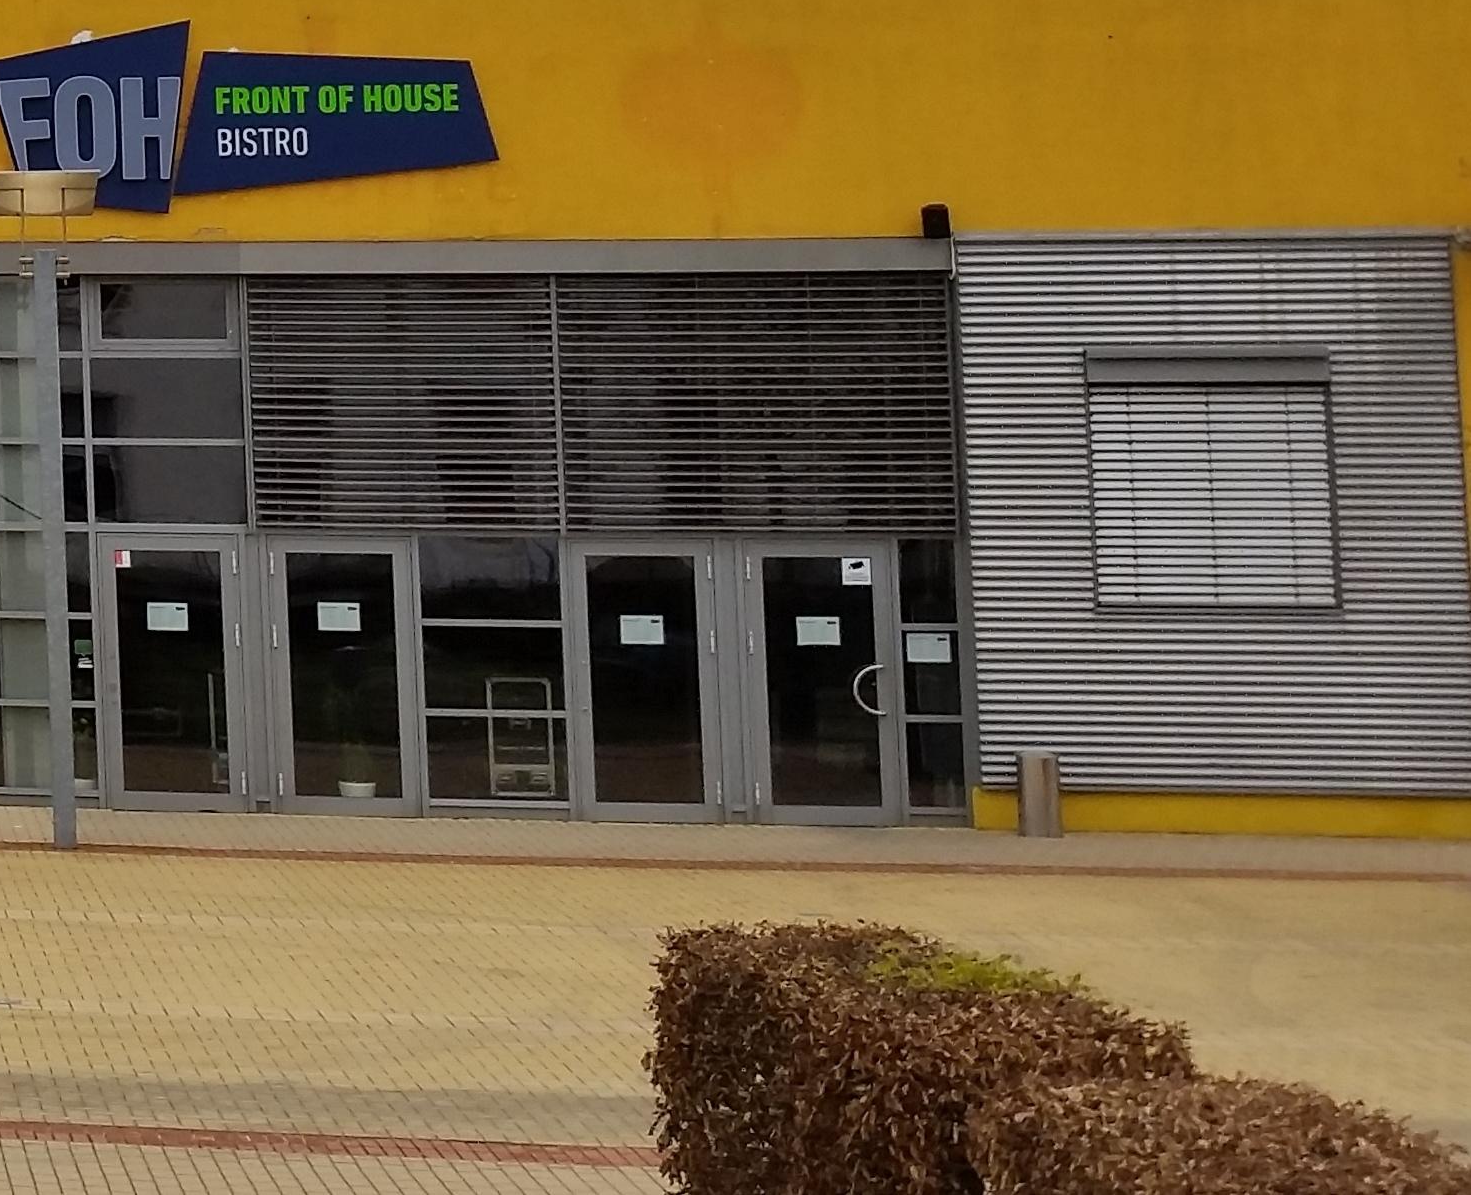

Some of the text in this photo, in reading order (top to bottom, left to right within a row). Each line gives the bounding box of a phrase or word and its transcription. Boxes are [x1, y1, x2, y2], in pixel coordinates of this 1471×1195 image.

[214, 83, 460, 115] FRONT OF HOUSE
[217, 127, 310, 157] BISTRO
